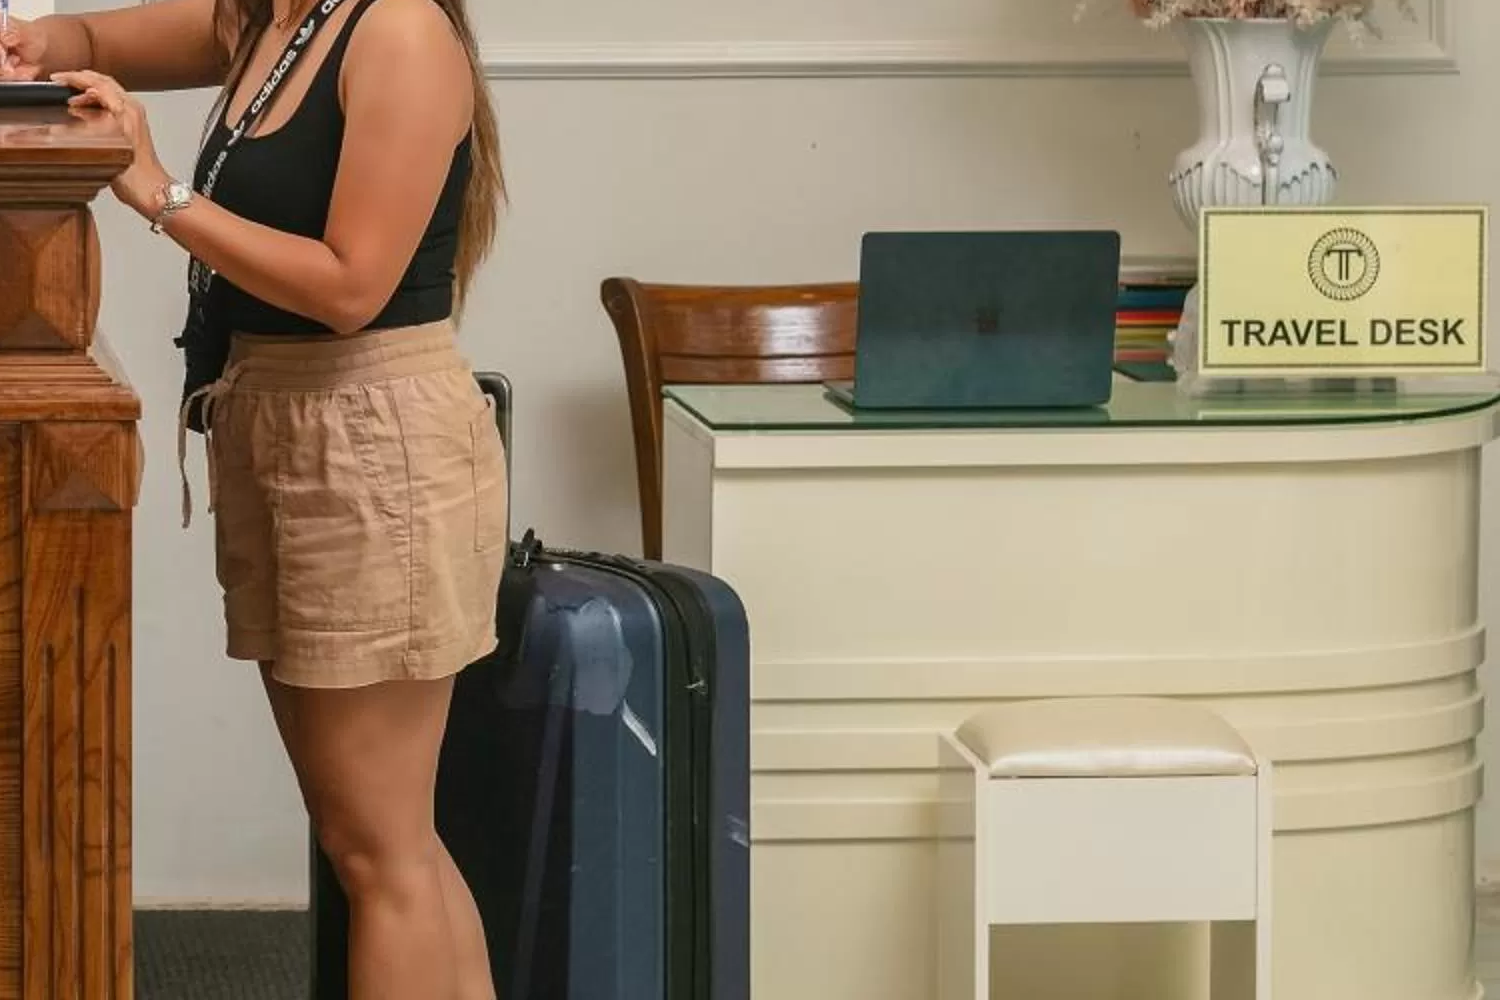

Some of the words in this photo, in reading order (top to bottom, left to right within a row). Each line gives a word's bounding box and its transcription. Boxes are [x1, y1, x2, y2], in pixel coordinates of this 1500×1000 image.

[251, 48, 298, 115] adidas
[1221, 318, 1359, 347] TRAVEL
[1369, 317, 1466, 346] DESK
